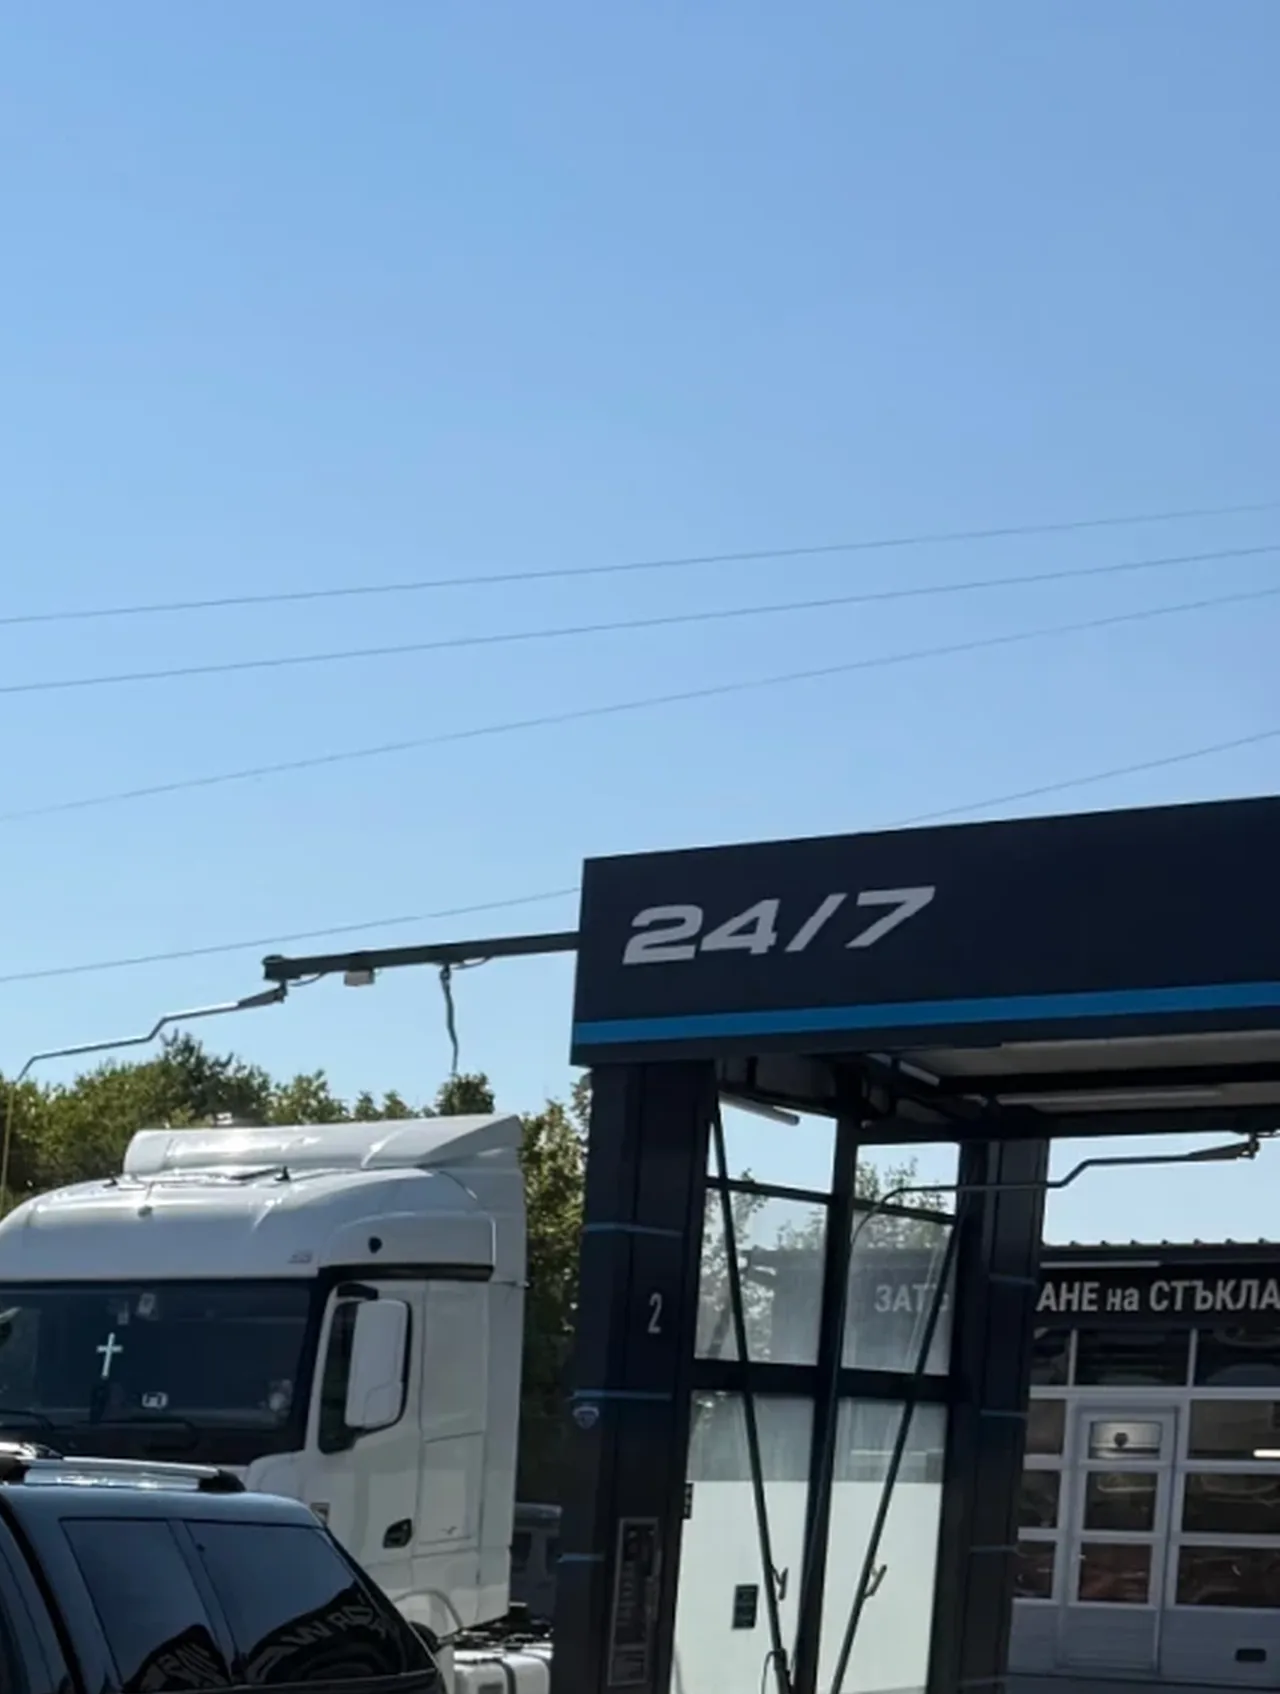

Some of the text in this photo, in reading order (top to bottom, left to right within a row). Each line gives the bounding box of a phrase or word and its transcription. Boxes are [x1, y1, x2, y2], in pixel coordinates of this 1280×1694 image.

[622, 886, 936, 965] 24/7
[648, 1292, 662, 1334] 2
[1106, 1287, 1140, 1312] на
[1149, 1278, 1280, 1311] СТЪКЛА
